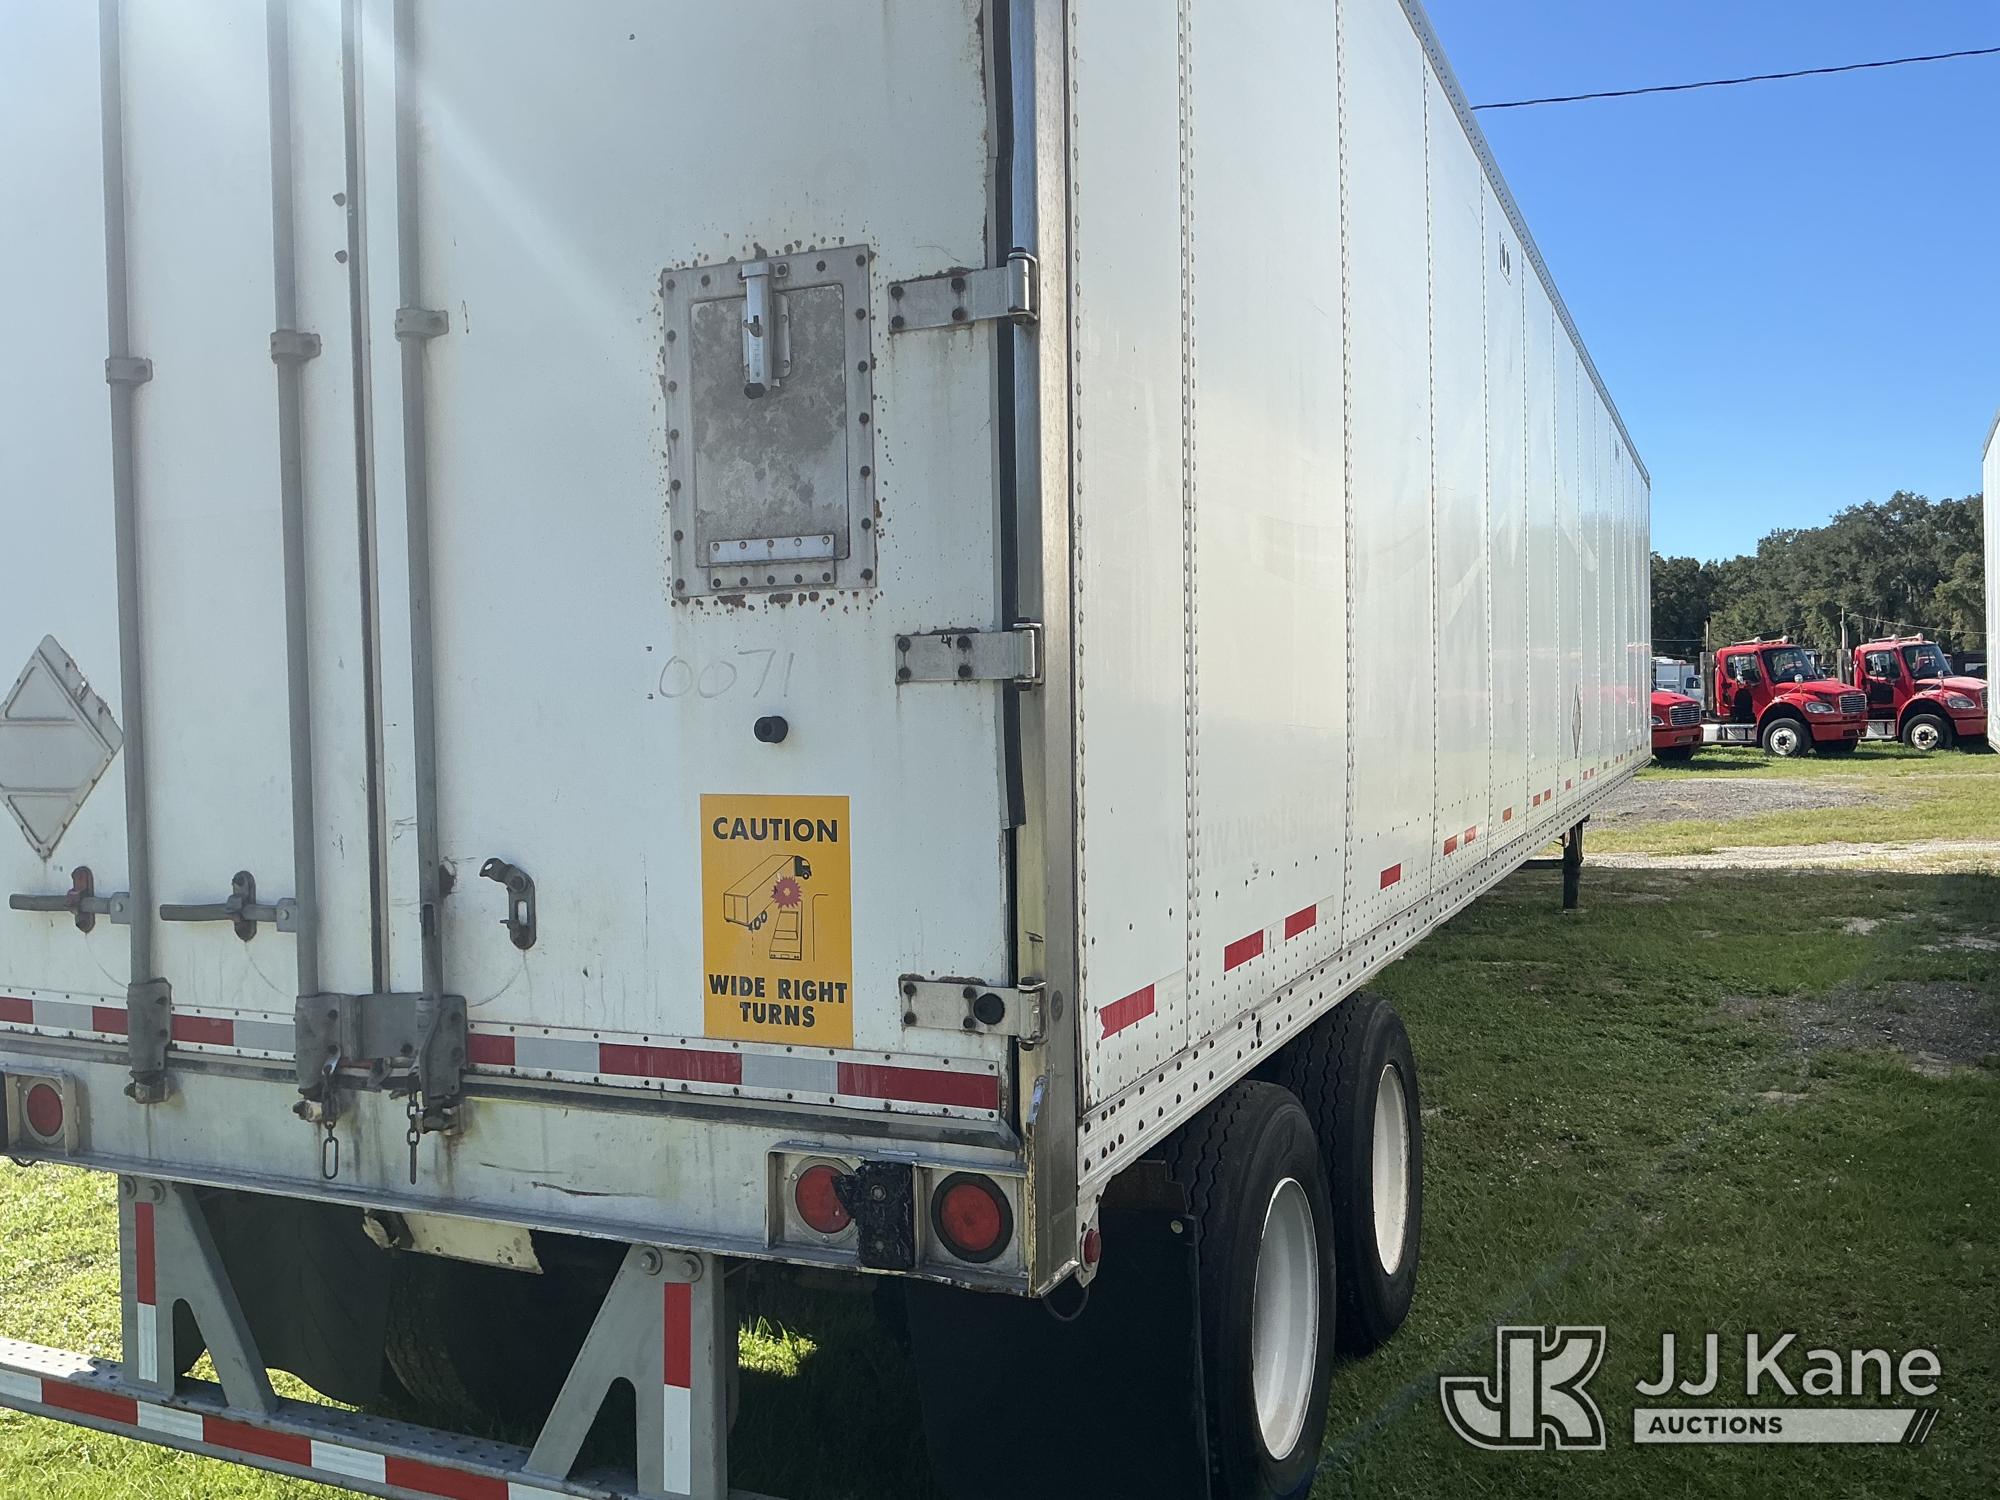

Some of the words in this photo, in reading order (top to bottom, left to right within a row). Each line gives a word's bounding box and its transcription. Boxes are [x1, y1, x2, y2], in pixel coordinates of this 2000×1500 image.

[659, 649, 795, 698] 0071
[712, 816, 838, 842] CAUTION
[709, 974, 765, 999] WIDE
[777, 978, 848, 1004] RIGHT
[739, 1001, 816, 1028] TURNS
